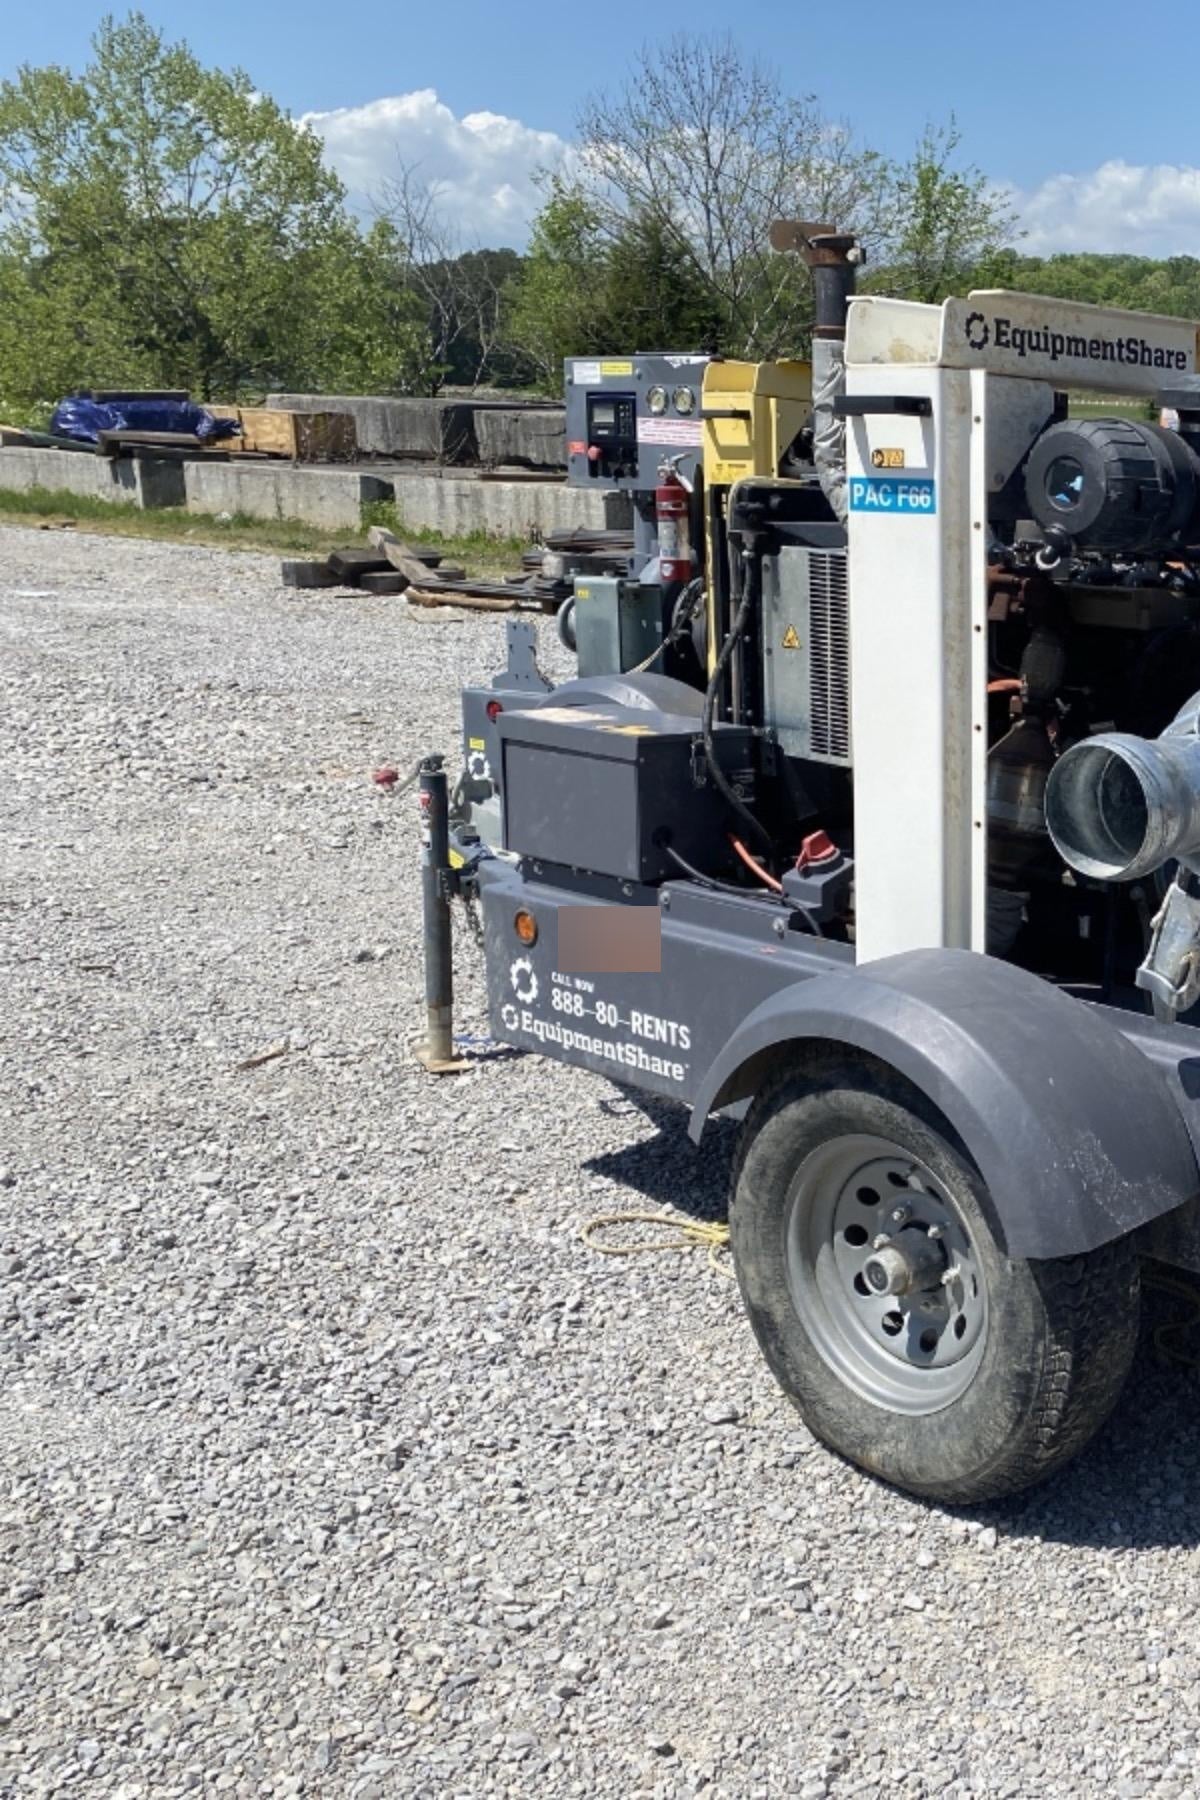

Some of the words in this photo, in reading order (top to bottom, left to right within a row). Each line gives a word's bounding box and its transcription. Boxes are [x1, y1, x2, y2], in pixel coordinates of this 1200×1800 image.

[993, 317, 1187, 371] EquipmentShare
[852, 483, 893, 507] PAC
[897, 484, 931, 509] F66
[551, 971, 572, 988] CALL
[574, 977, 594, 994] NOW
[521, 1010, 685, 1081] EquipmentShare
